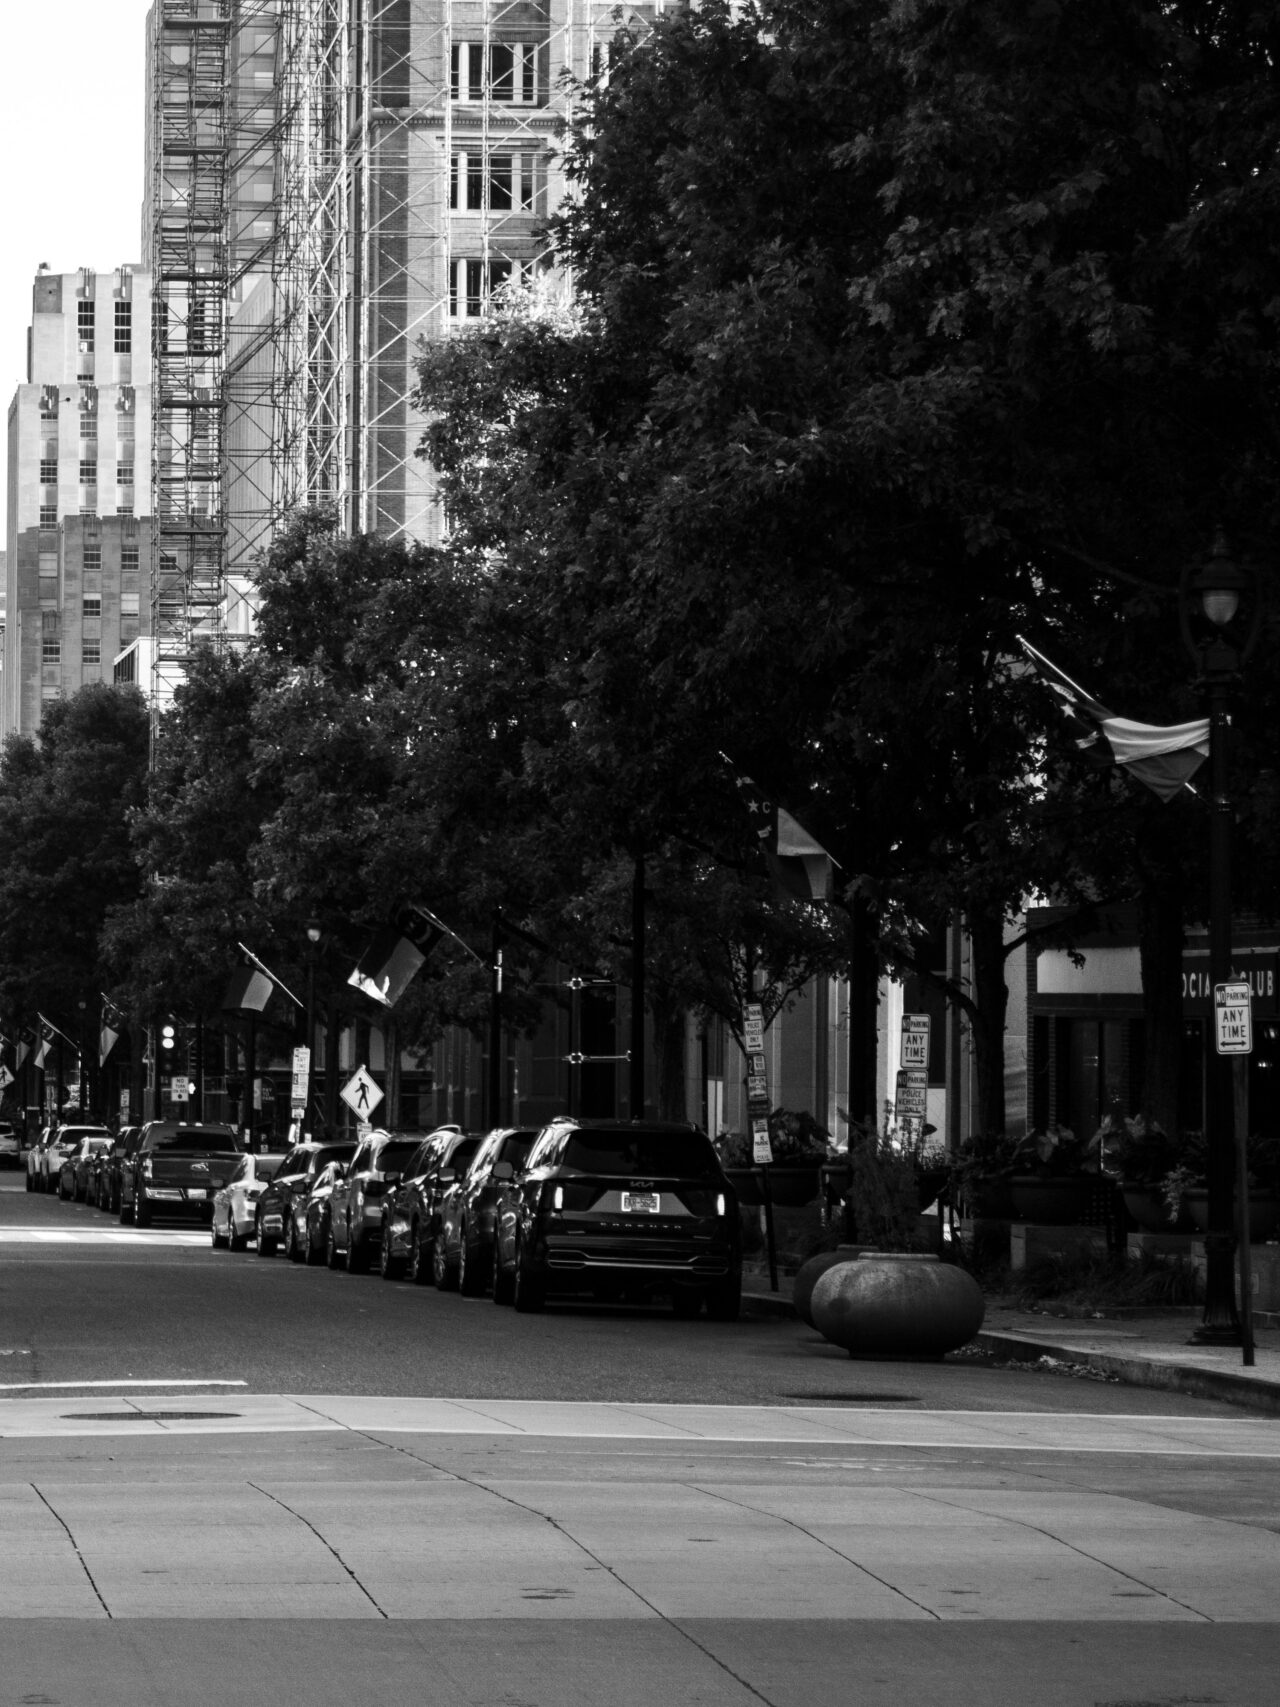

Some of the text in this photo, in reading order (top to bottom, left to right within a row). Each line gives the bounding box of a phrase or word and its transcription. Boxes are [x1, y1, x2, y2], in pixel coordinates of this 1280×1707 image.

[762, 801, 771, 814] C
[1181, 971, 1211, 998] OCIA
[1216, 990, 1248, 1004] NO PARKING
[1223, 1009, 1243, 1022] ANY
[902, 1020, 928, 1029] NO PARKING
[1221, 1025, 1246, 1038] TIME
[906, 1035, 924, 1045] ANY
[905, 1047, 925, 1058] TIME
[898, 1075, 926, 1084] NO PARKING
[902, 1090, 921, 1098] POLICE
[898, 1098, 925, 1106] VEHICLES
